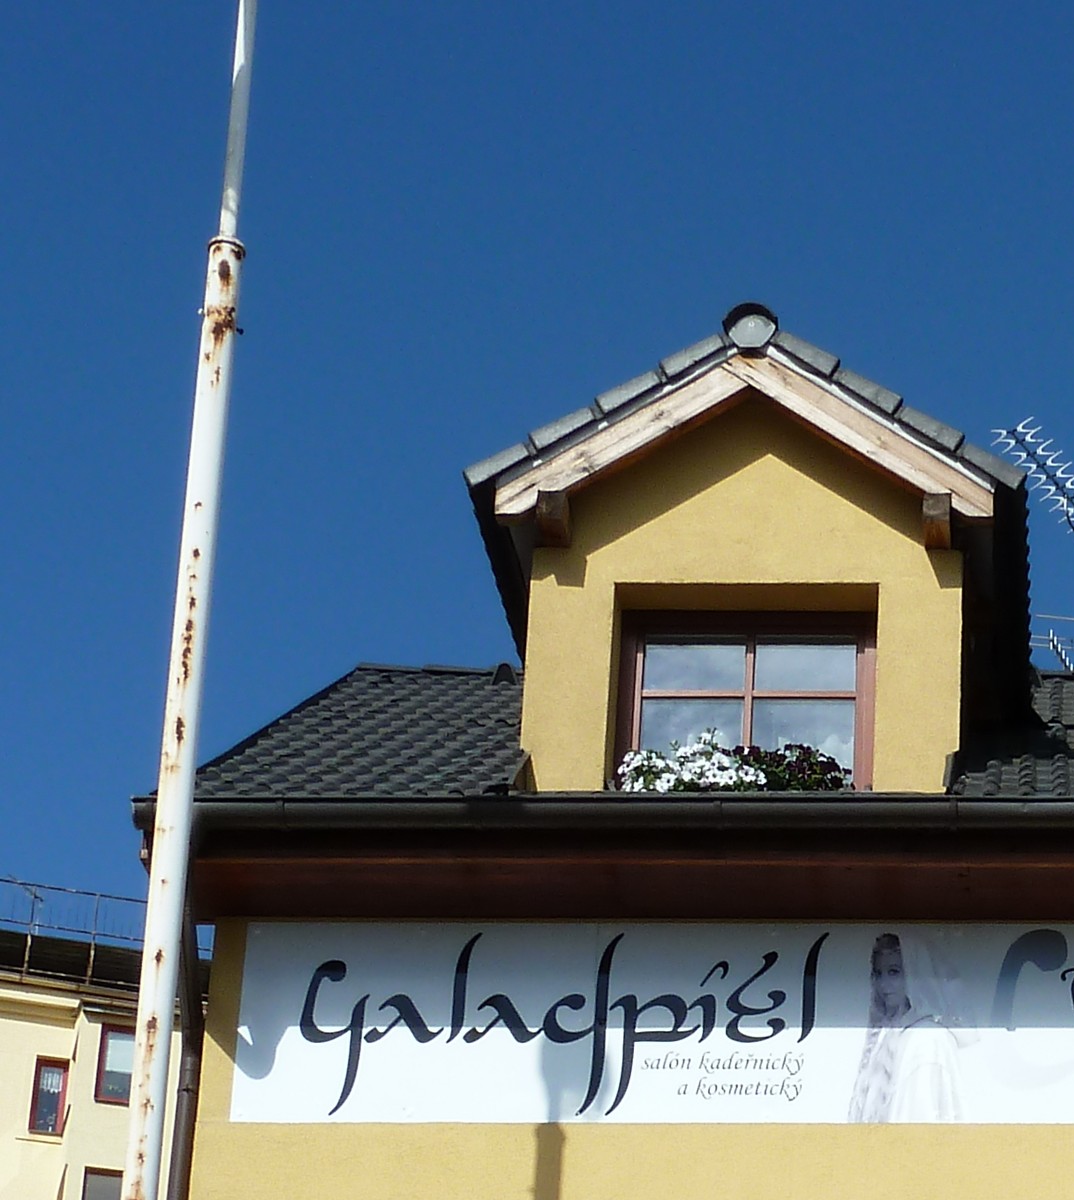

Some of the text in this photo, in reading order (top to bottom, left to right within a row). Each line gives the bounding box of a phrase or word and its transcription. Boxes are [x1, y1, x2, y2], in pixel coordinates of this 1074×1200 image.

[640, 1051, 805, 1076] salón kadeřnický
[677, 1076, 803, 1102] a kosmetický
